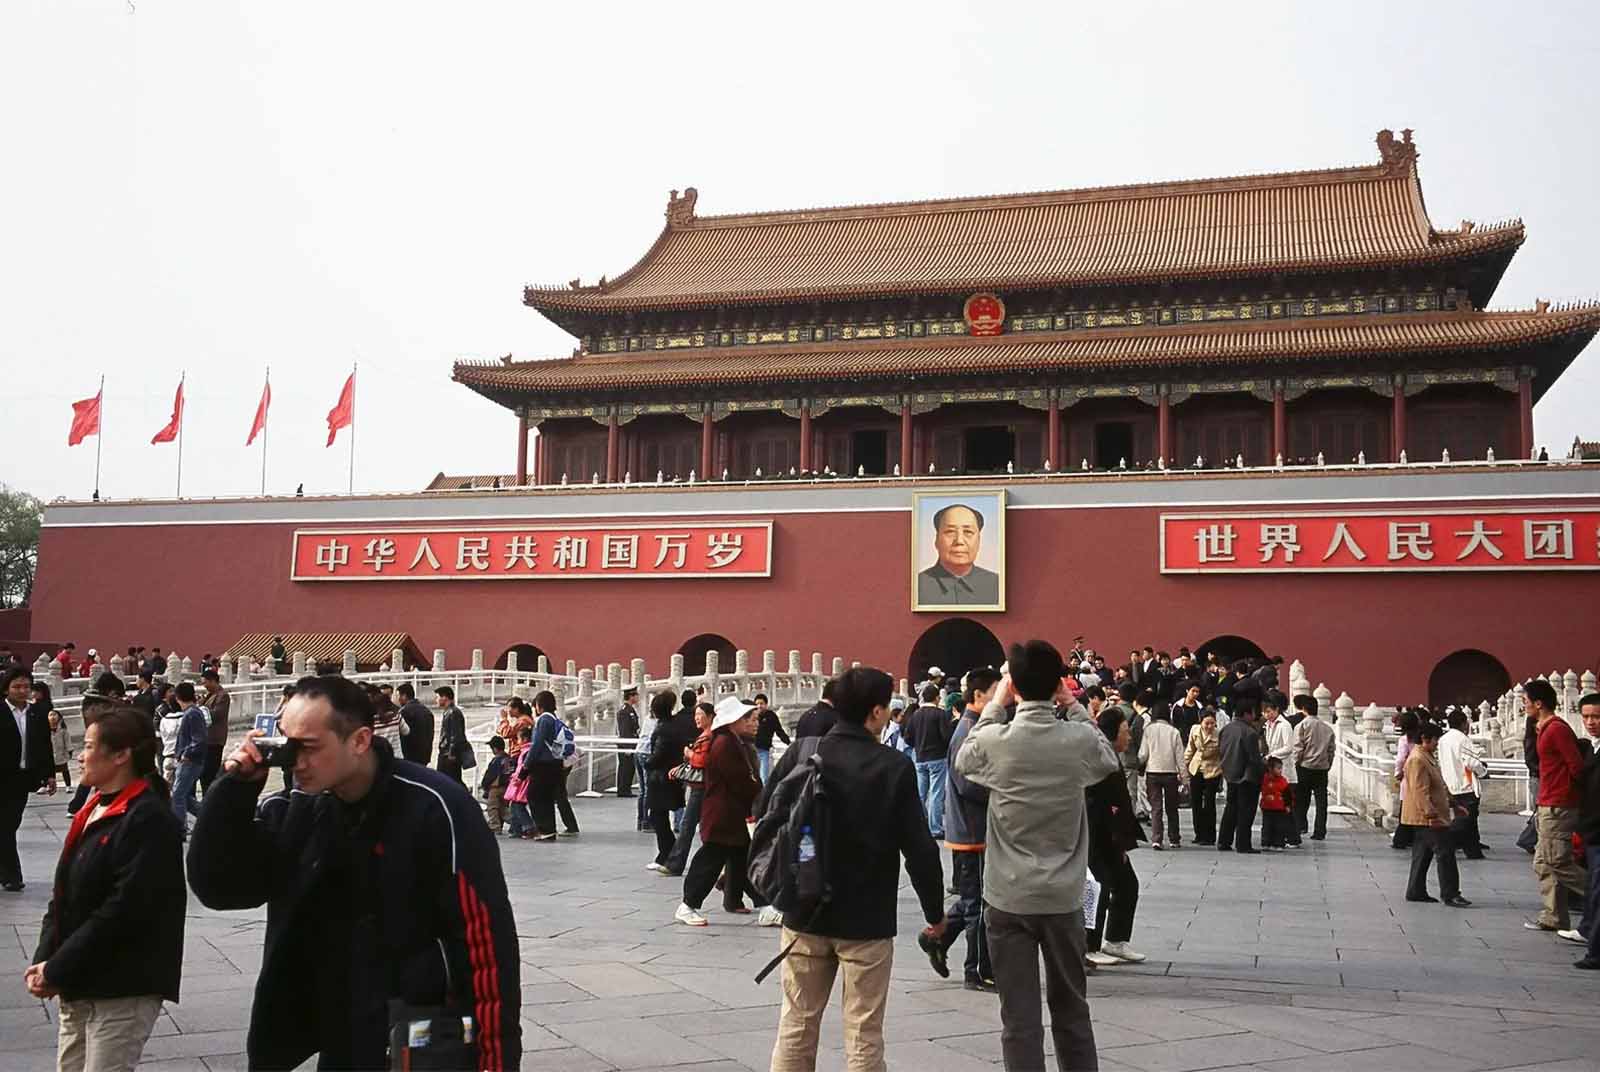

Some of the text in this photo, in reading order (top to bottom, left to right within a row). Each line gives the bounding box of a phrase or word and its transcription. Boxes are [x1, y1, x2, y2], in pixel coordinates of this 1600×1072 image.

[315, 533, 745, 572] 中华人民共和国万岁
[1193, 519, 1600, 564] 世界人民大团
